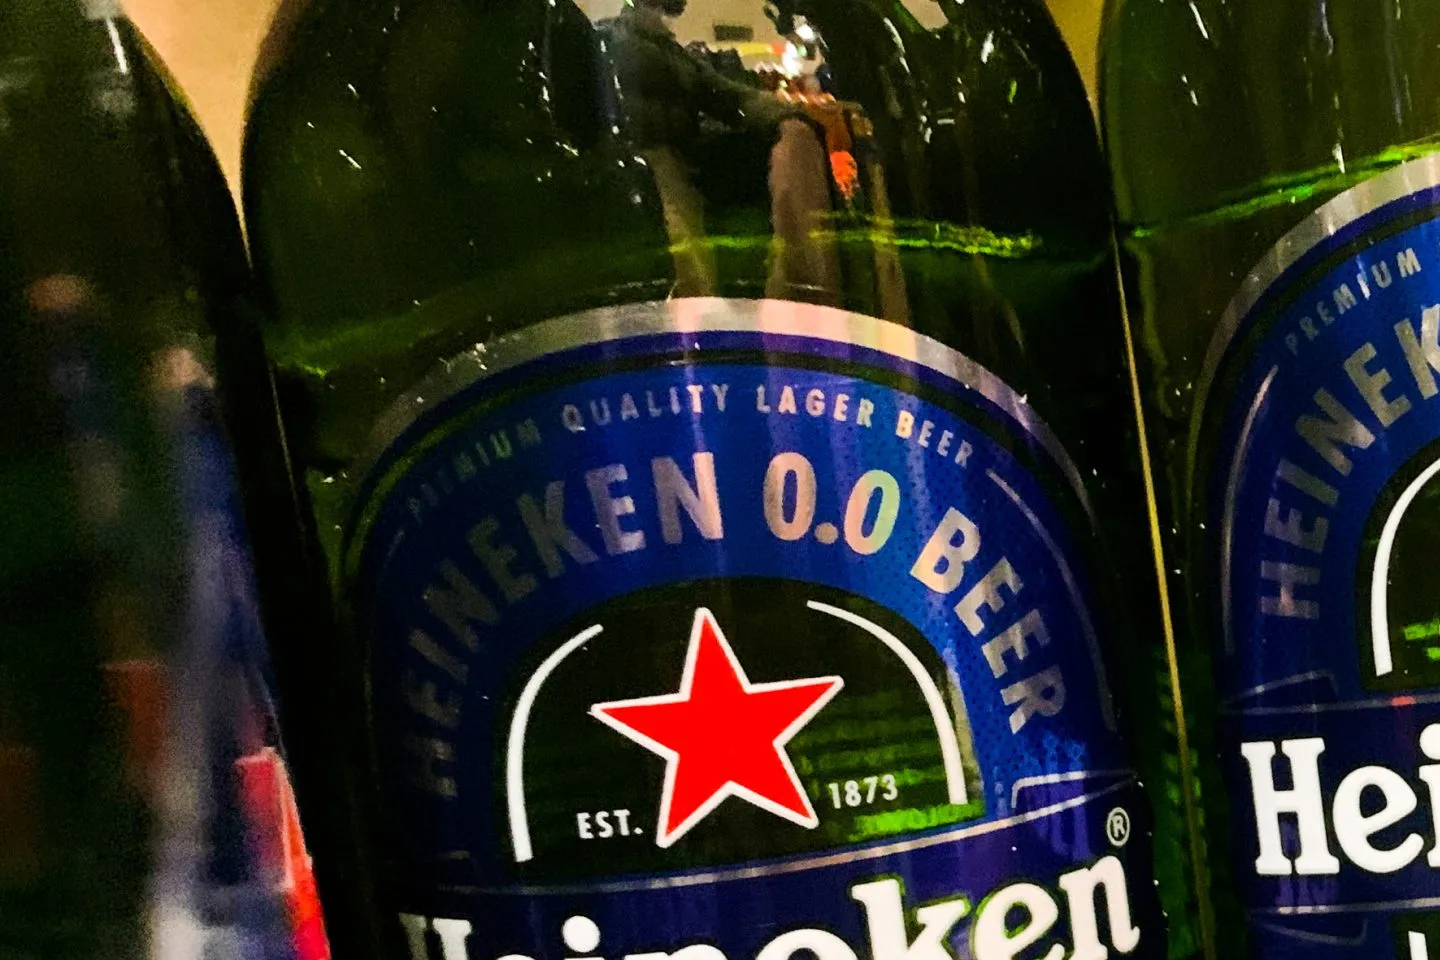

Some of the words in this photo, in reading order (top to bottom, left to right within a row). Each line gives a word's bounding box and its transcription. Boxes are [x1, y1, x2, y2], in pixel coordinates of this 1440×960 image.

[1284, 248, 1421, 356] PREMIUM
[560, 382, 729, 433] QUALITY
[755, 384, 875, 428] LAGER
[895, 411, 974, 469] BEER
[403, 451, 725, 799] HEINEKEN
[763, 452, 900, 555] 0.0
[910, 506, 1067, 734] BEER
[576, 808, 644, 840] EST.
[828, 774, 898, 809] 1873
